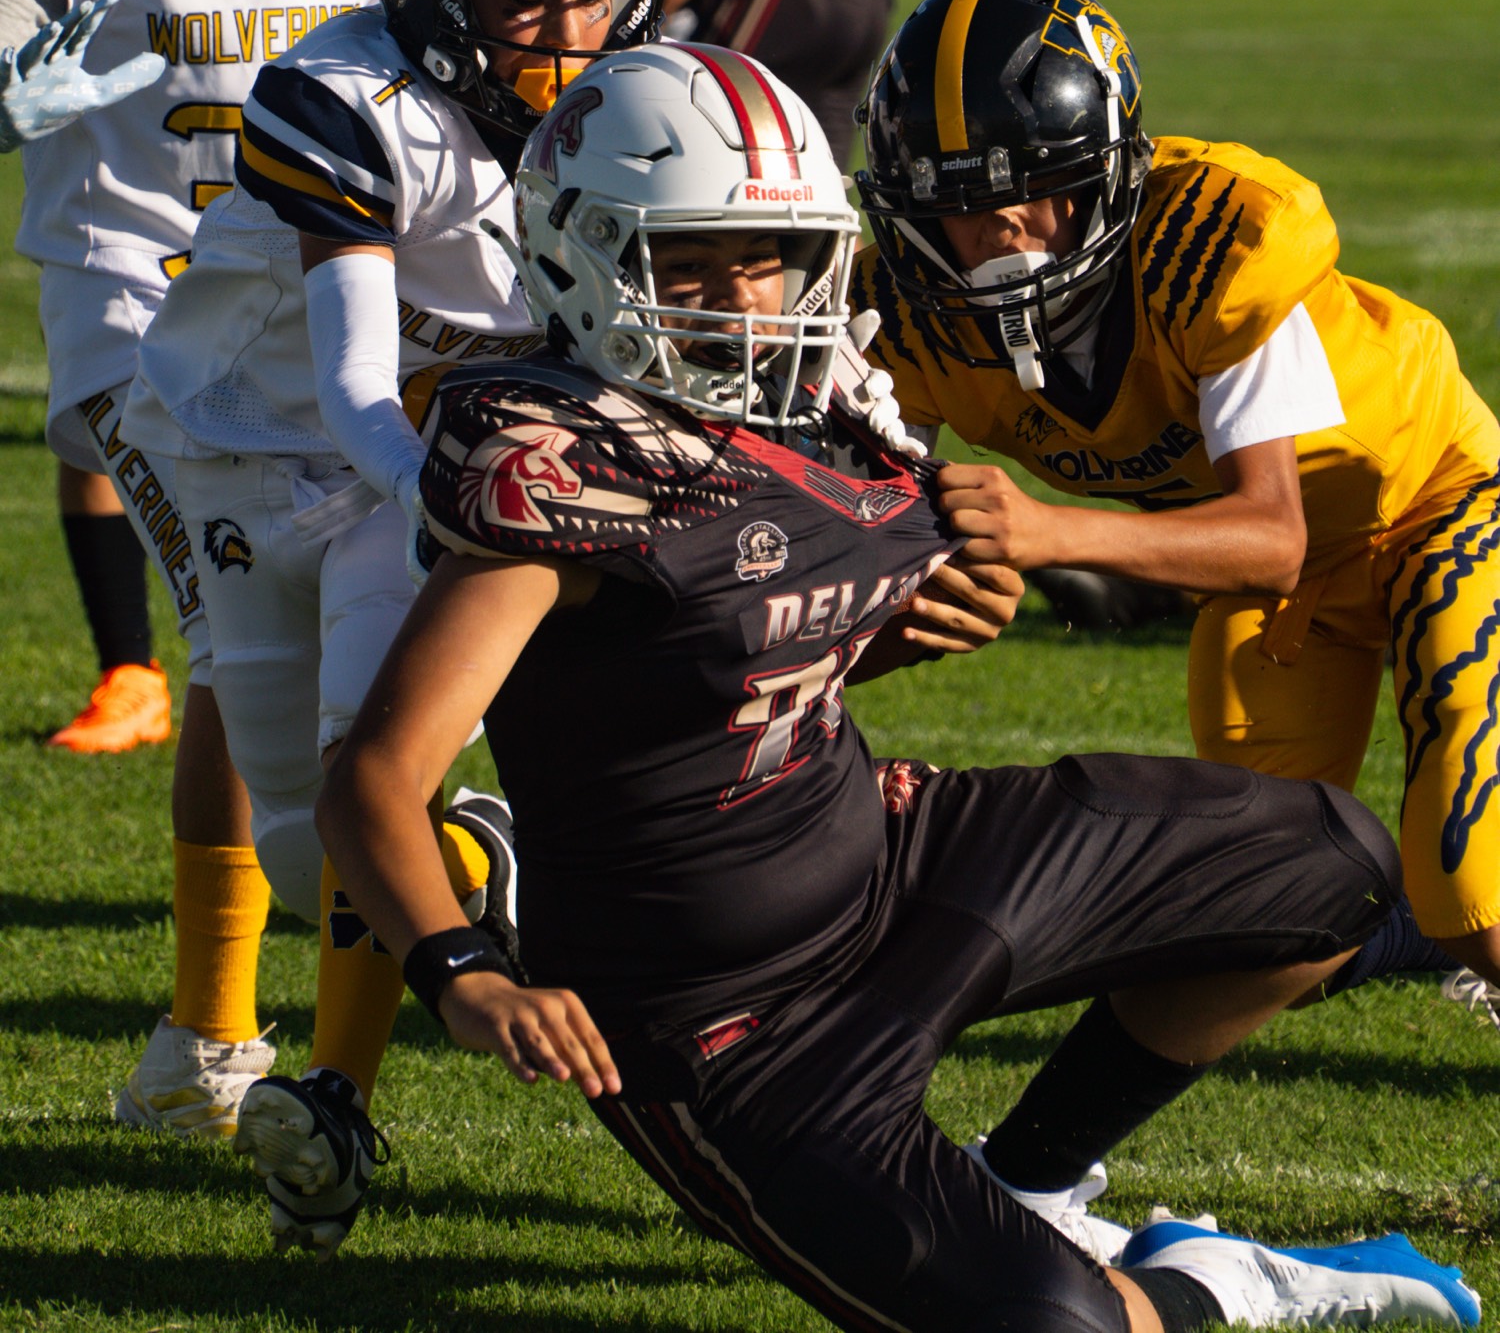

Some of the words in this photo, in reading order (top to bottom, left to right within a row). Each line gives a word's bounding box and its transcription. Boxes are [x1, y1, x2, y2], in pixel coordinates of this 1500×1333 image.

[941, 155, 983, 170] schutt
[745, 184, 814, 201] Riddell
[1002, 292, 1031, 348] NTRND
[711, 379, 745, 390] Riddel
